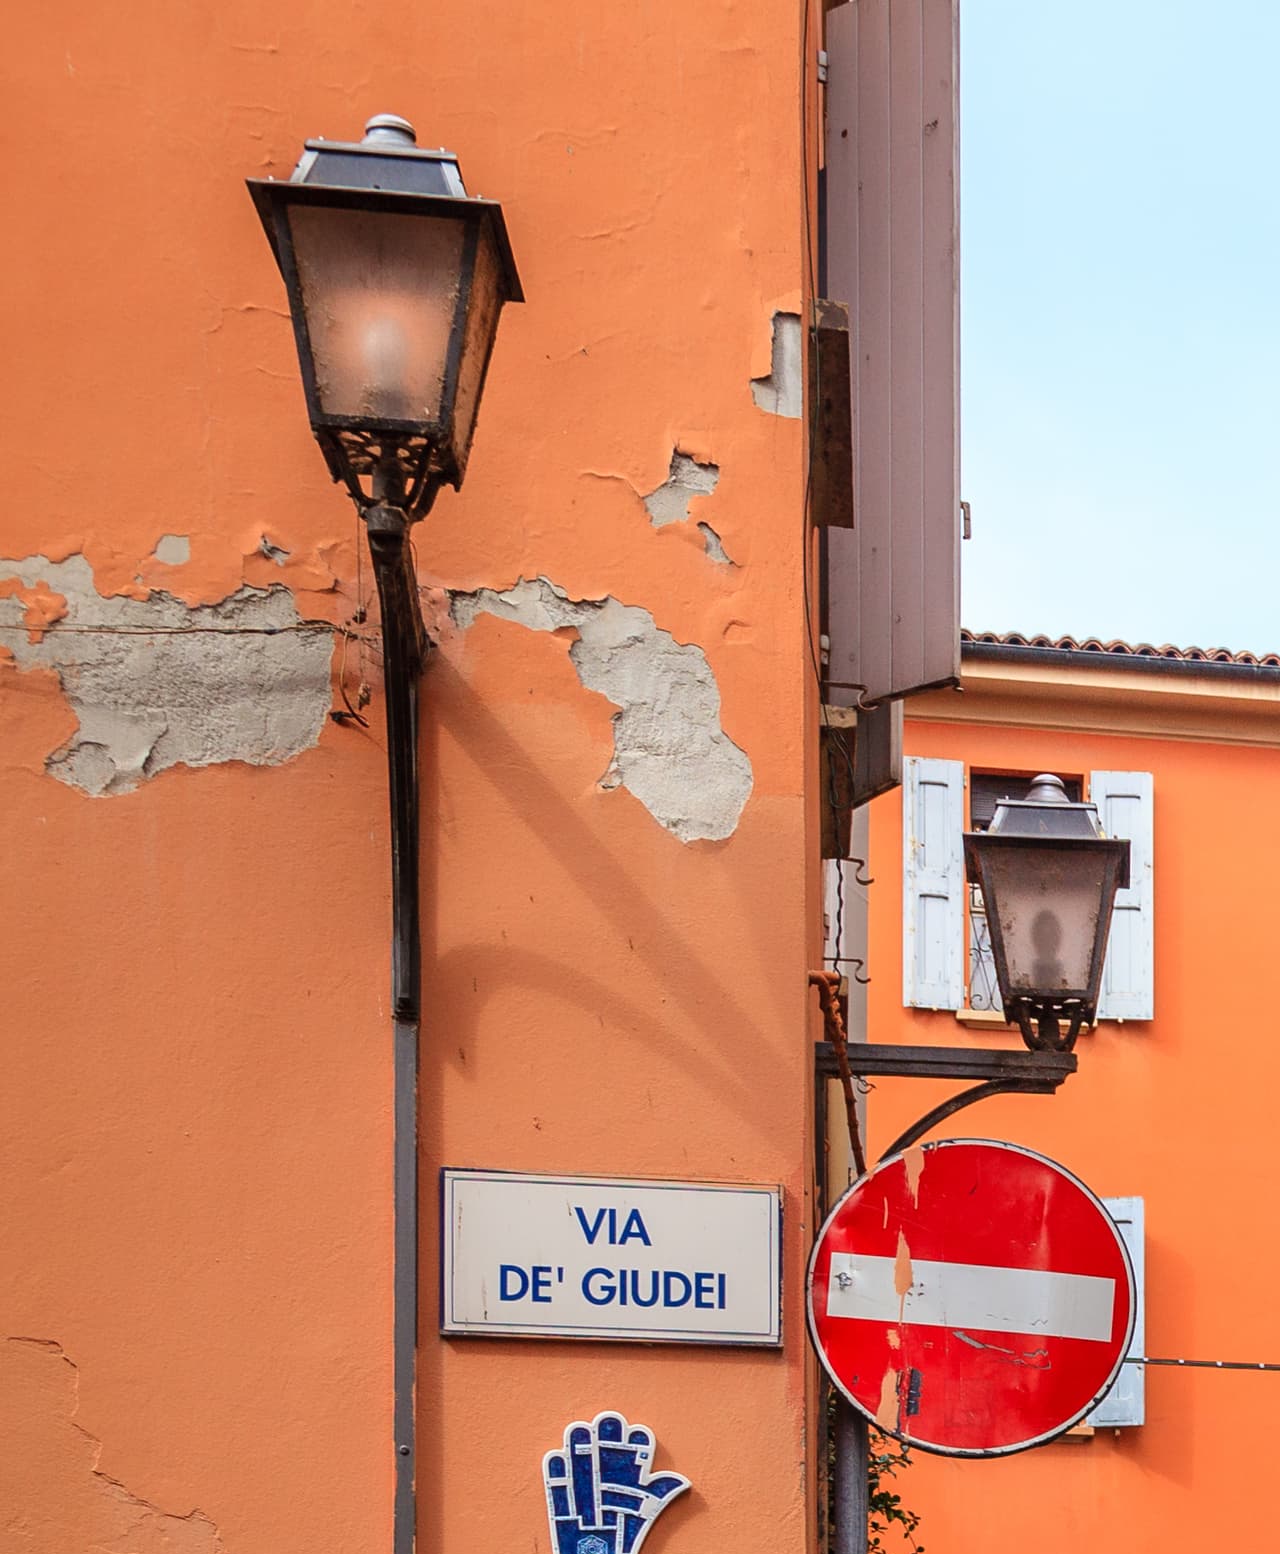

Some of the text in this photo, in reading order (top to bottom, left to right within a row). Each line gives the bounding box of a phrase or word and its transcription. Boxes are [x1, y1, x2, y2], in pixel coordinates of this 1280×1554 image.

[574, 1206, 652, 1247] VIA
[499, 1264, 726, 1310] DE' GIUDEI
